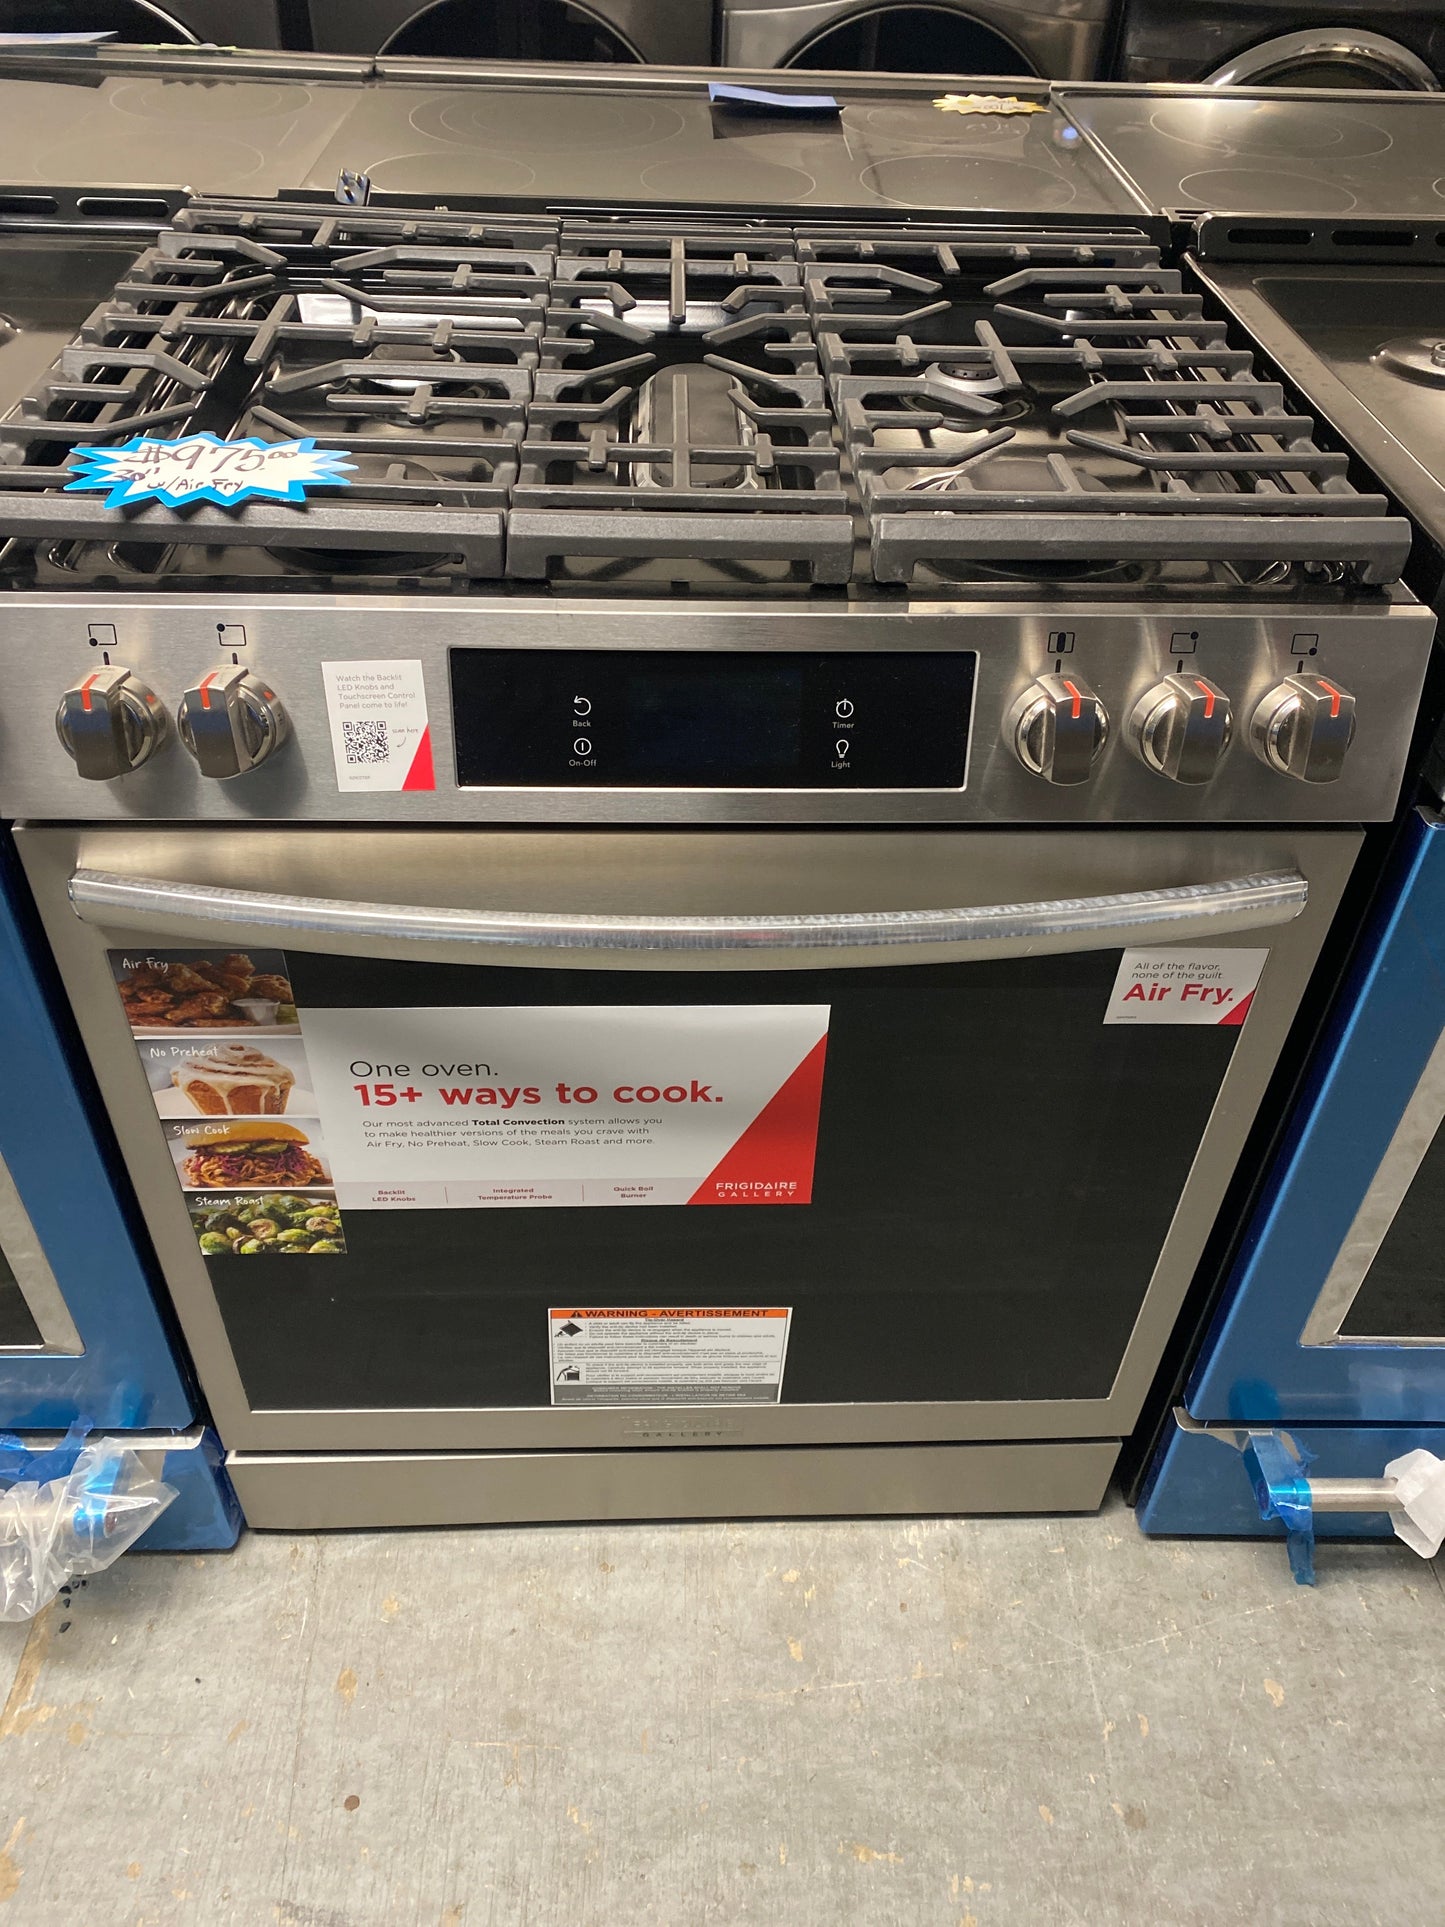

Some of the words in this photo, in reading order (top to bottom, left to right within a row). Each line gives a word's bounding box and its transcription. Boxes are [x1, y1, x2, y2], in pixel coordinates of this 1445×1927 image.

[211, 478, 244, 492] Fry
[568, 759, 597, 767] On-Off
[831, 761, 851, 770] Light
[122, 958, 141, 969] Air
[146, 957, 168, 973] Fry
[1177, 971, 1195, 979] the
[1122, 982, 1172, 1001] Air
[1180, 983, 1234, 1005] Fry.
[150, 1047, 166, 1058] No
[170, 1046, 219, 1057] Preheat
[350, 1061, 410, 1077] One
[422, 1063, 498, 1077] oven.
[354, 1084, 422, 1106] 15+
[439, 1087, 542, 1109] ways
[556, 1083, 598, 1104] to
[613, 1080, 723, 1104] cook.
[363, 1120, 383, 1128] Our
[417, 1119, 468, 1127] advanced
[644, 1118, 663, 1126] you
[173, 1125, 199, 1136] Slow
[204, 1124, 231, 1135] Cook
[385, 1140, 405, 1148] Fry,
[502, 1139, 531, 1147] Cook,
[716, 1182, 797, 1190] FRIGIDAIRE
[195, 1197, 231, 1206] Steam
[234, 1196, 264, 1206] Roast
[585, 1310, 648, 1318] WARNING
